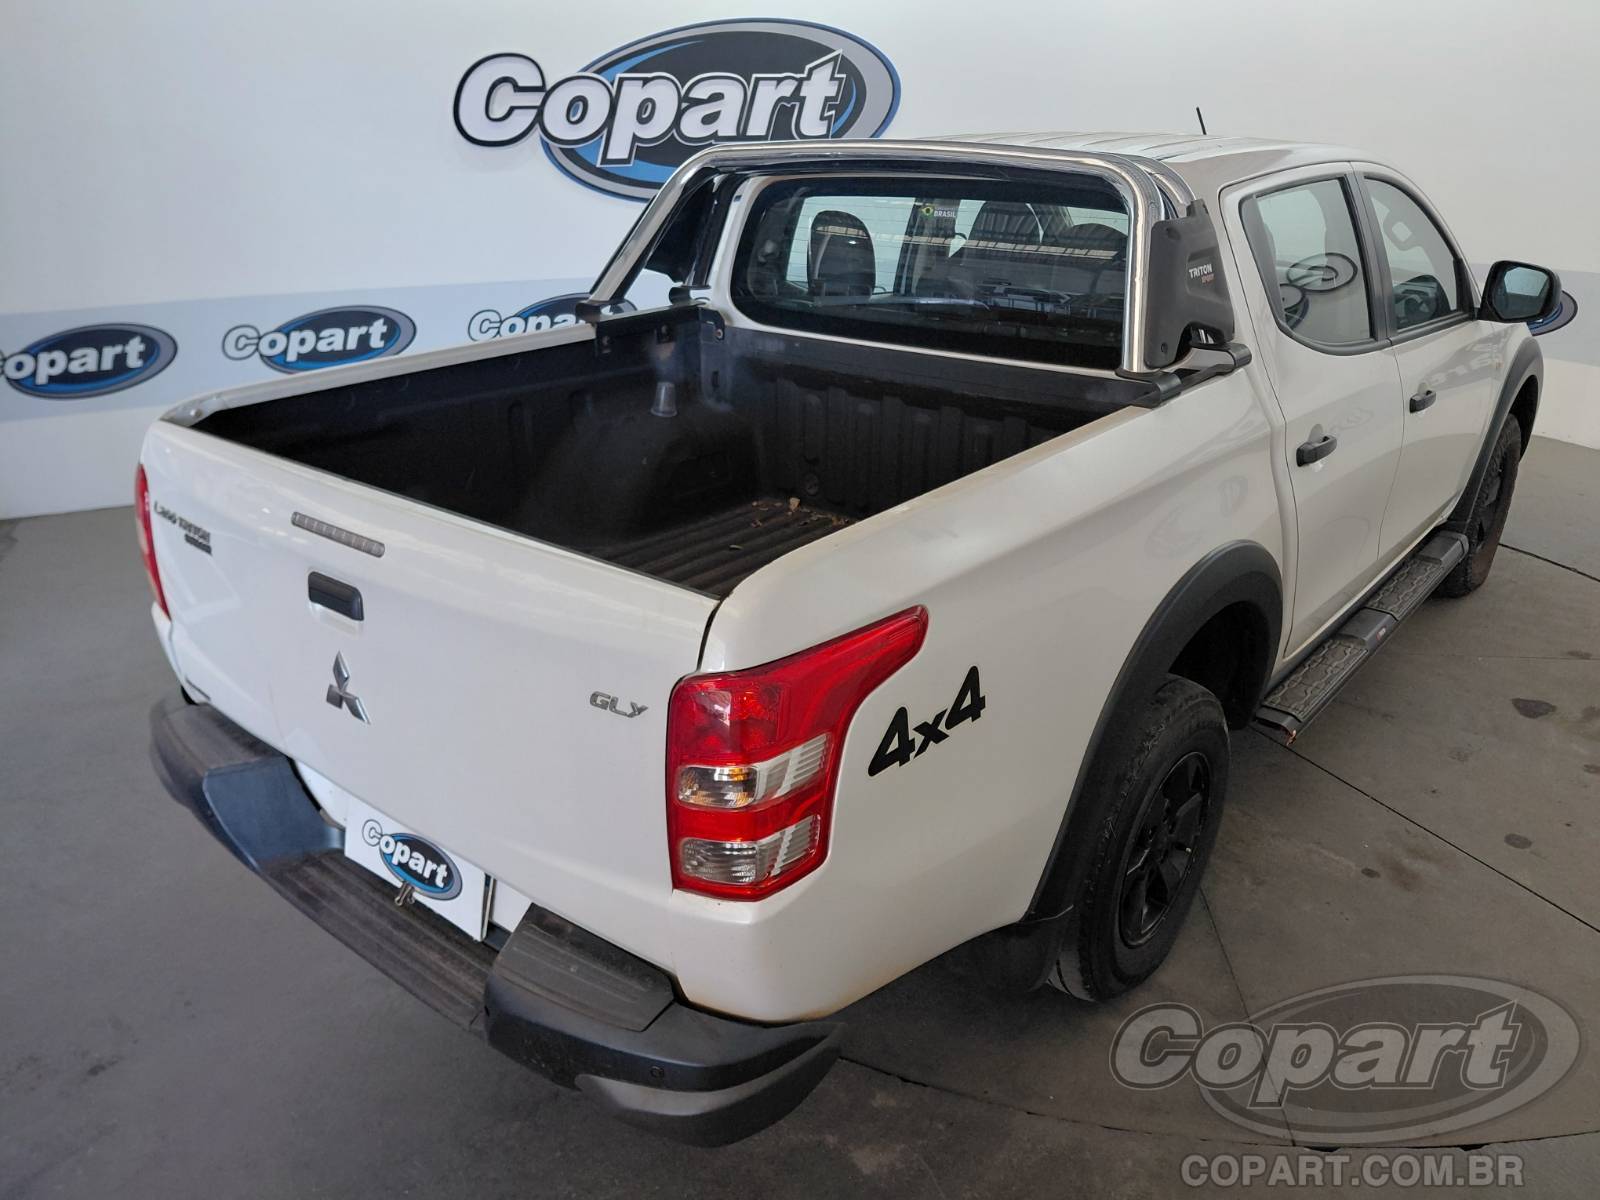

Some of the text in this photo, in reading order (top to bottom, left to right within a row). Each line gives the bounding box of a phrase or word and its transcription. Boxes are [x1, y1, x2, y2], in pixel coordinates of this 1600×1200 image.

[453, 50, 846, 166] Copart
[1189, 263, 1213, 279] TRITON
[0, 336, 146, 386] opart
[222, 317, 388, 362] Copart
[868, 666, 986, 777] 4x4
[362, 819, 448, 889] Copart
